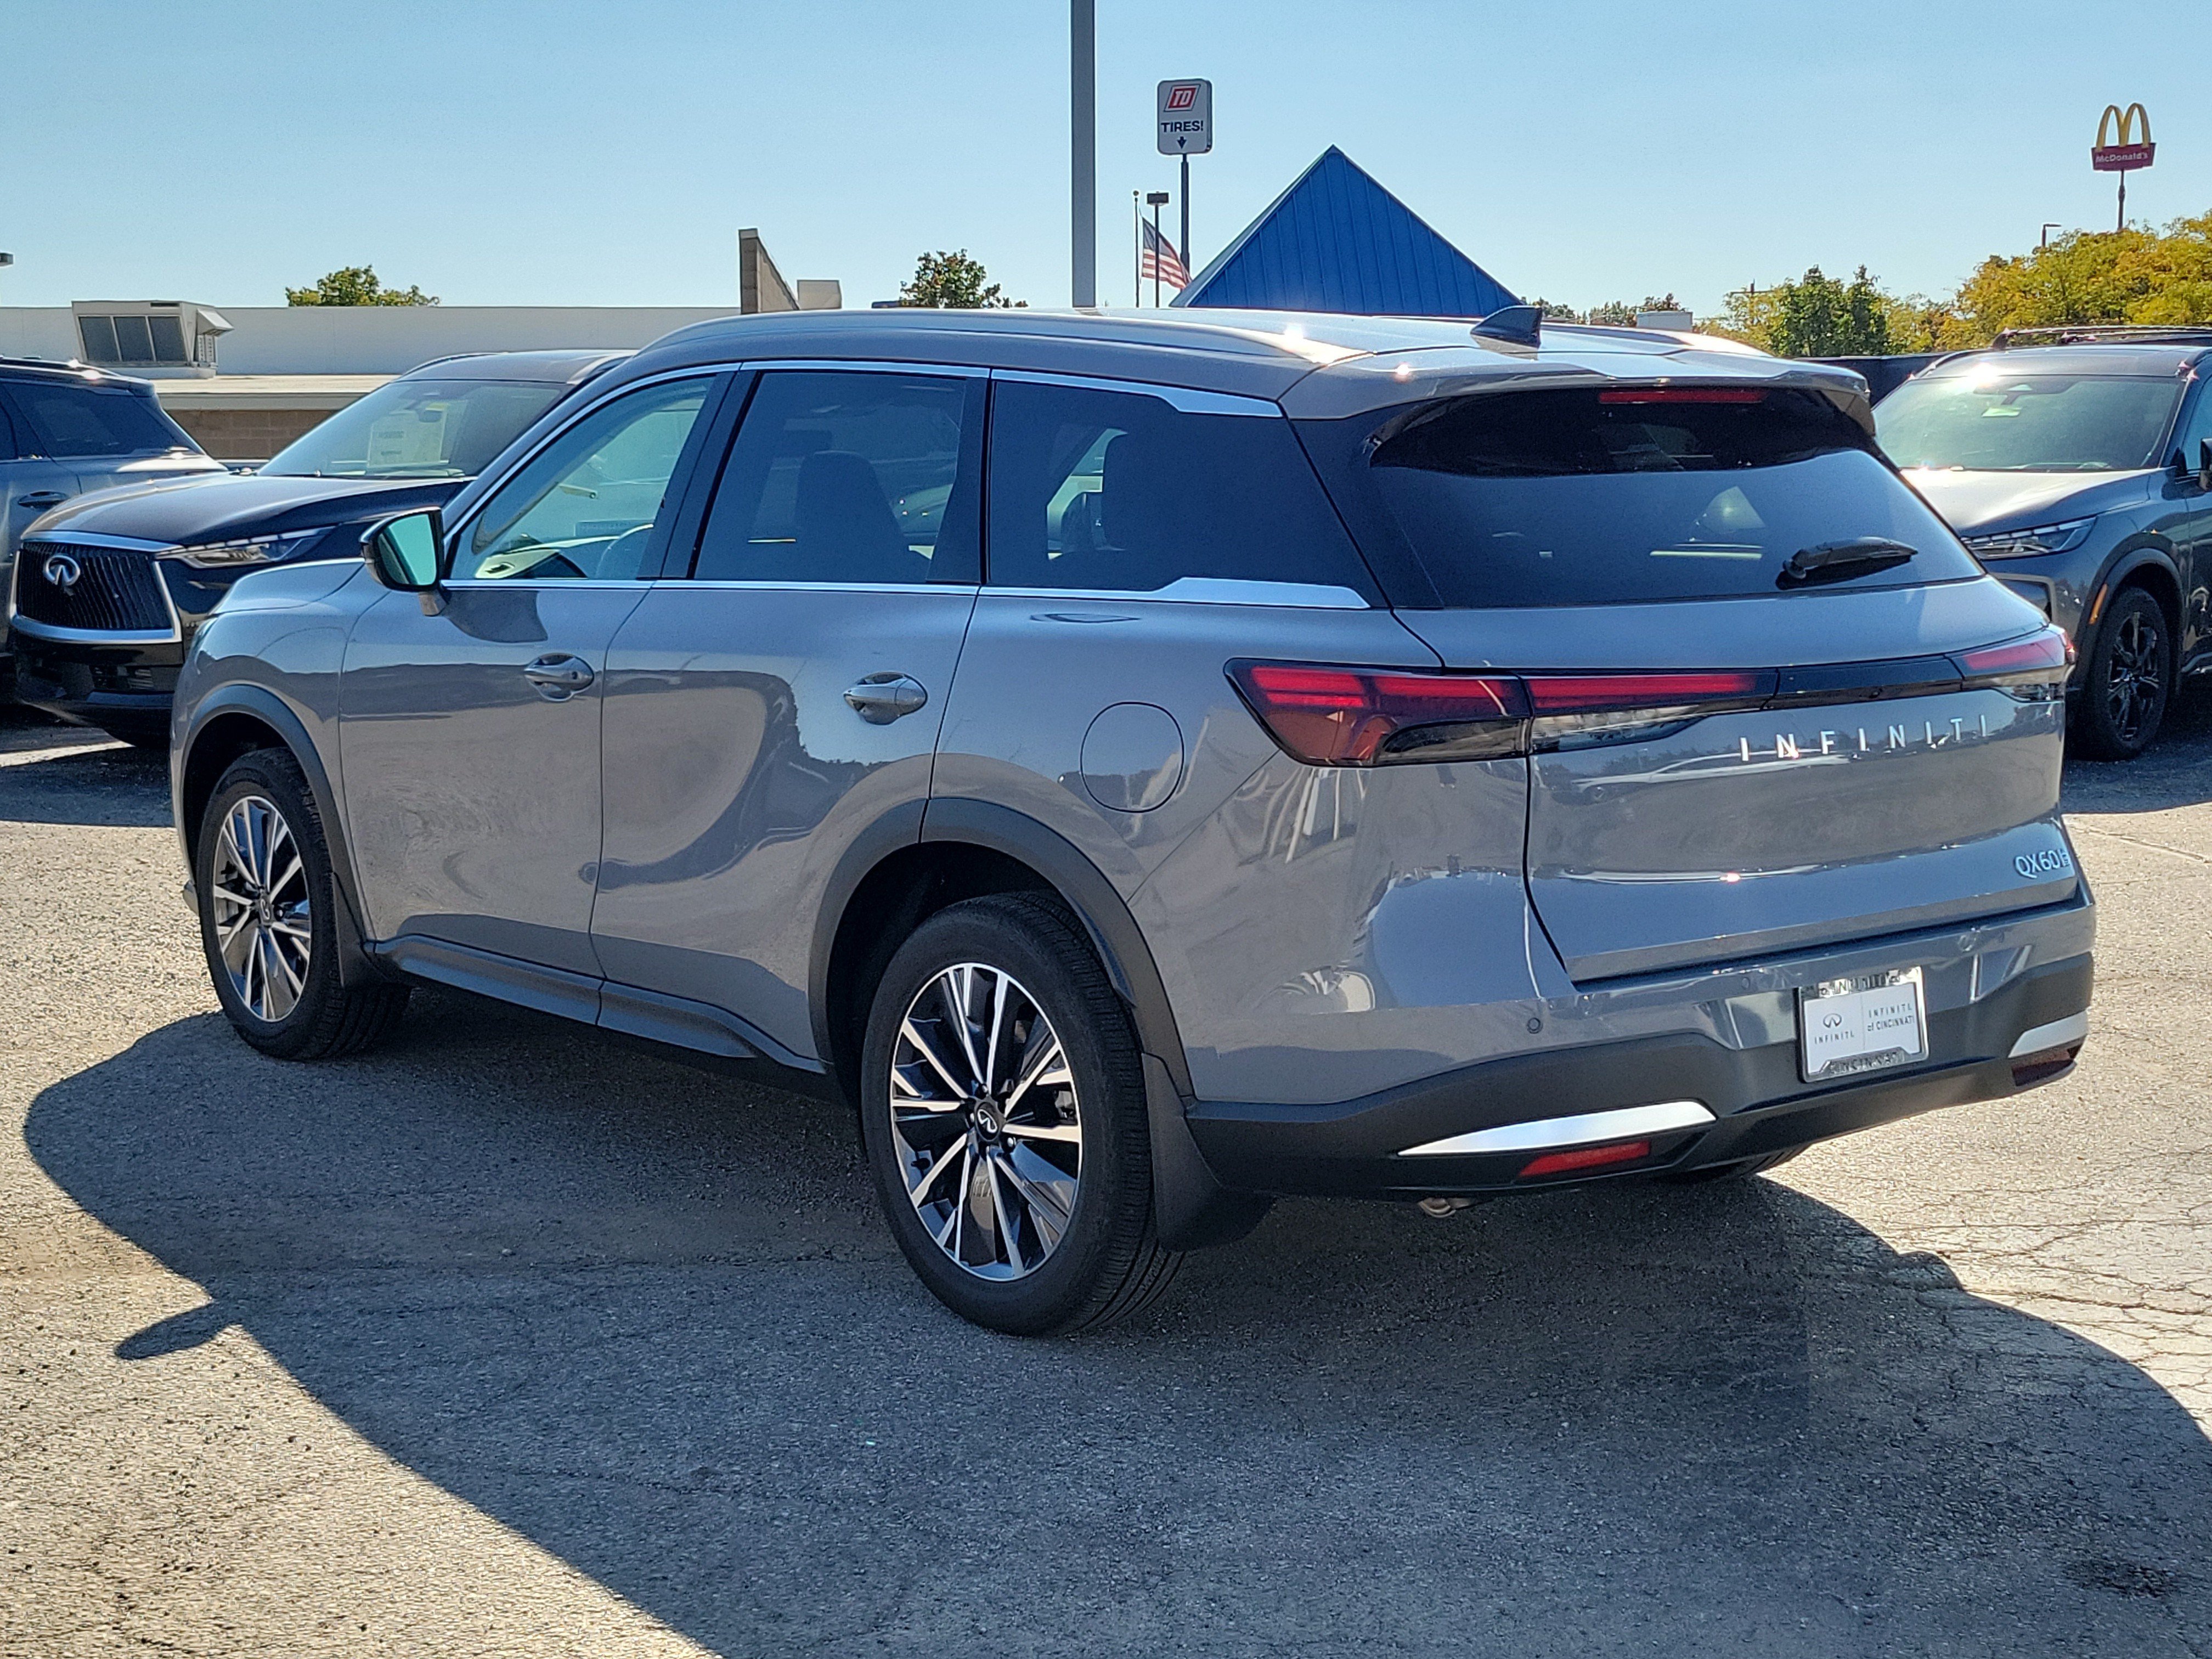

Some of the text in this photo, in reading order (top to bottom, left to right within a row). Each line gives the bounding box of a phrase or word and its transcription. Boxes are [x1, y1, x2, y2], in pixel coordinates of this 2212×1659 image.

[1160, 120, 1204, 133] TIRES!
[2095, 152, 2149, 163] McDonald's
[1739, 714, 1989, 762] INFINITI
[1868, 1003, 1912, 1018] INFINITI
[1876, 1015, 1915, 1031] CINCINNATI
[1814, 1030, 1855, 1045] INFINITI
